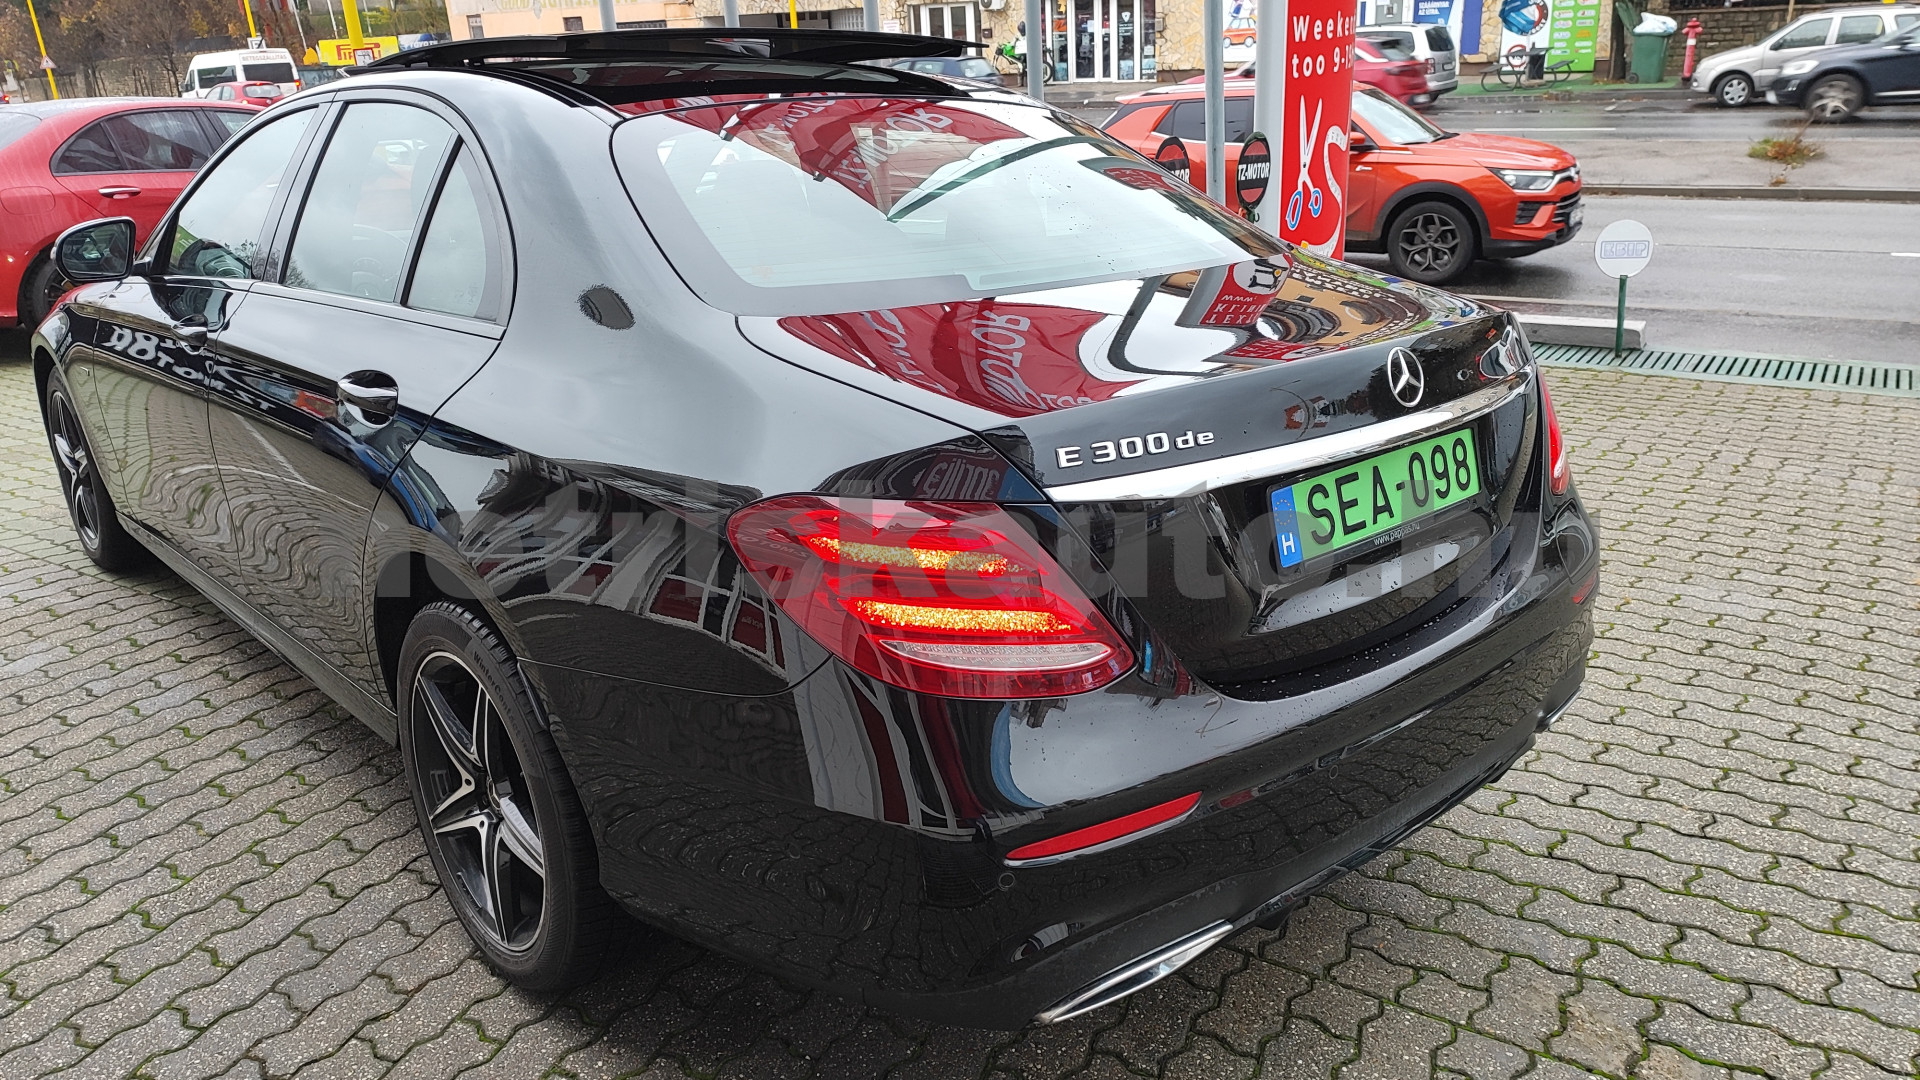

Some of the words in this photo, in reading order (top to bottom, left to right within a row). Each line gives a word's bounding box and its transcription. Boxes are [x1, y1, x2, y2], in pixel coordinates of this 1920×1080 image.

[1291, 53, 1326, 79] too
[1237, 161, 1270, 181] TZ-MOTOR
[1056, 446, 1084, 469] E
[1307, 437, 1471, 546] SEA-098
[1281, 530, 1296, 556] H
